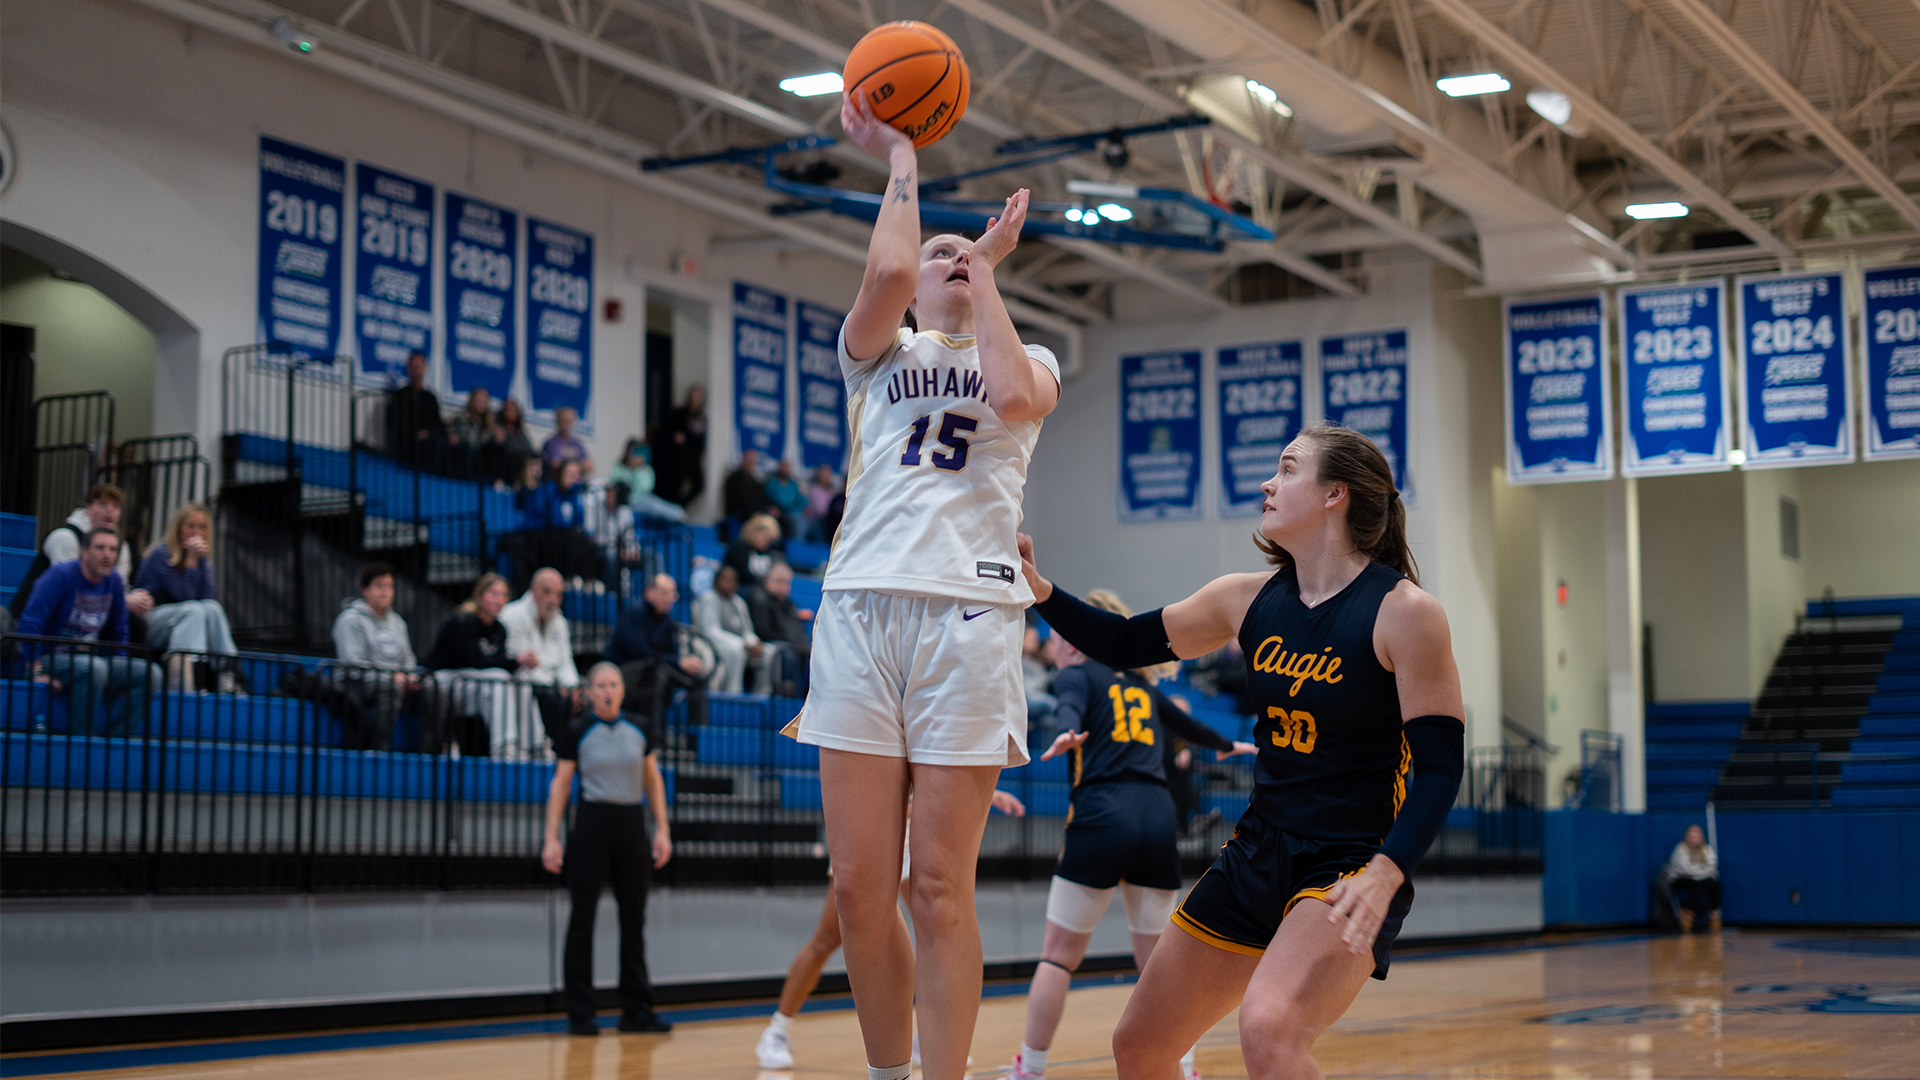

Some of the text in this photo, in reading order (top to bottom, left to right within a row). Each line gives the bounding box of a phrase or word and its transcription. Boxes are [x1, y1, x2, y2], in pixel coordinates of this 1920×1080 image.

[266, 191, 338, 244] 2019
[361, 216, 428, 267] 2019
[450, 241, 513, 292] 2020
[530, 265, 589, 313] 2020
[1512, 308, 1600, 332] VOLLEYBALL
[1752, 316, 1836, 355] 2024
[1875, 309, 1920, 344] 20
[1518, 336, 1595, 375] 2023
[1634, 326, 1714, 364] 2023
[1126, 387, 1196, 424] 2022
[1225, 379, 1297, 416] 2022
[1328, 369, 1401, 406] 2022
[899, 410, 981, 474] 15
[1253, 635, 1343, 697] Augie
[1108, 684, 1154, 746] 12
[1267, 706, 1318, 754] 30
